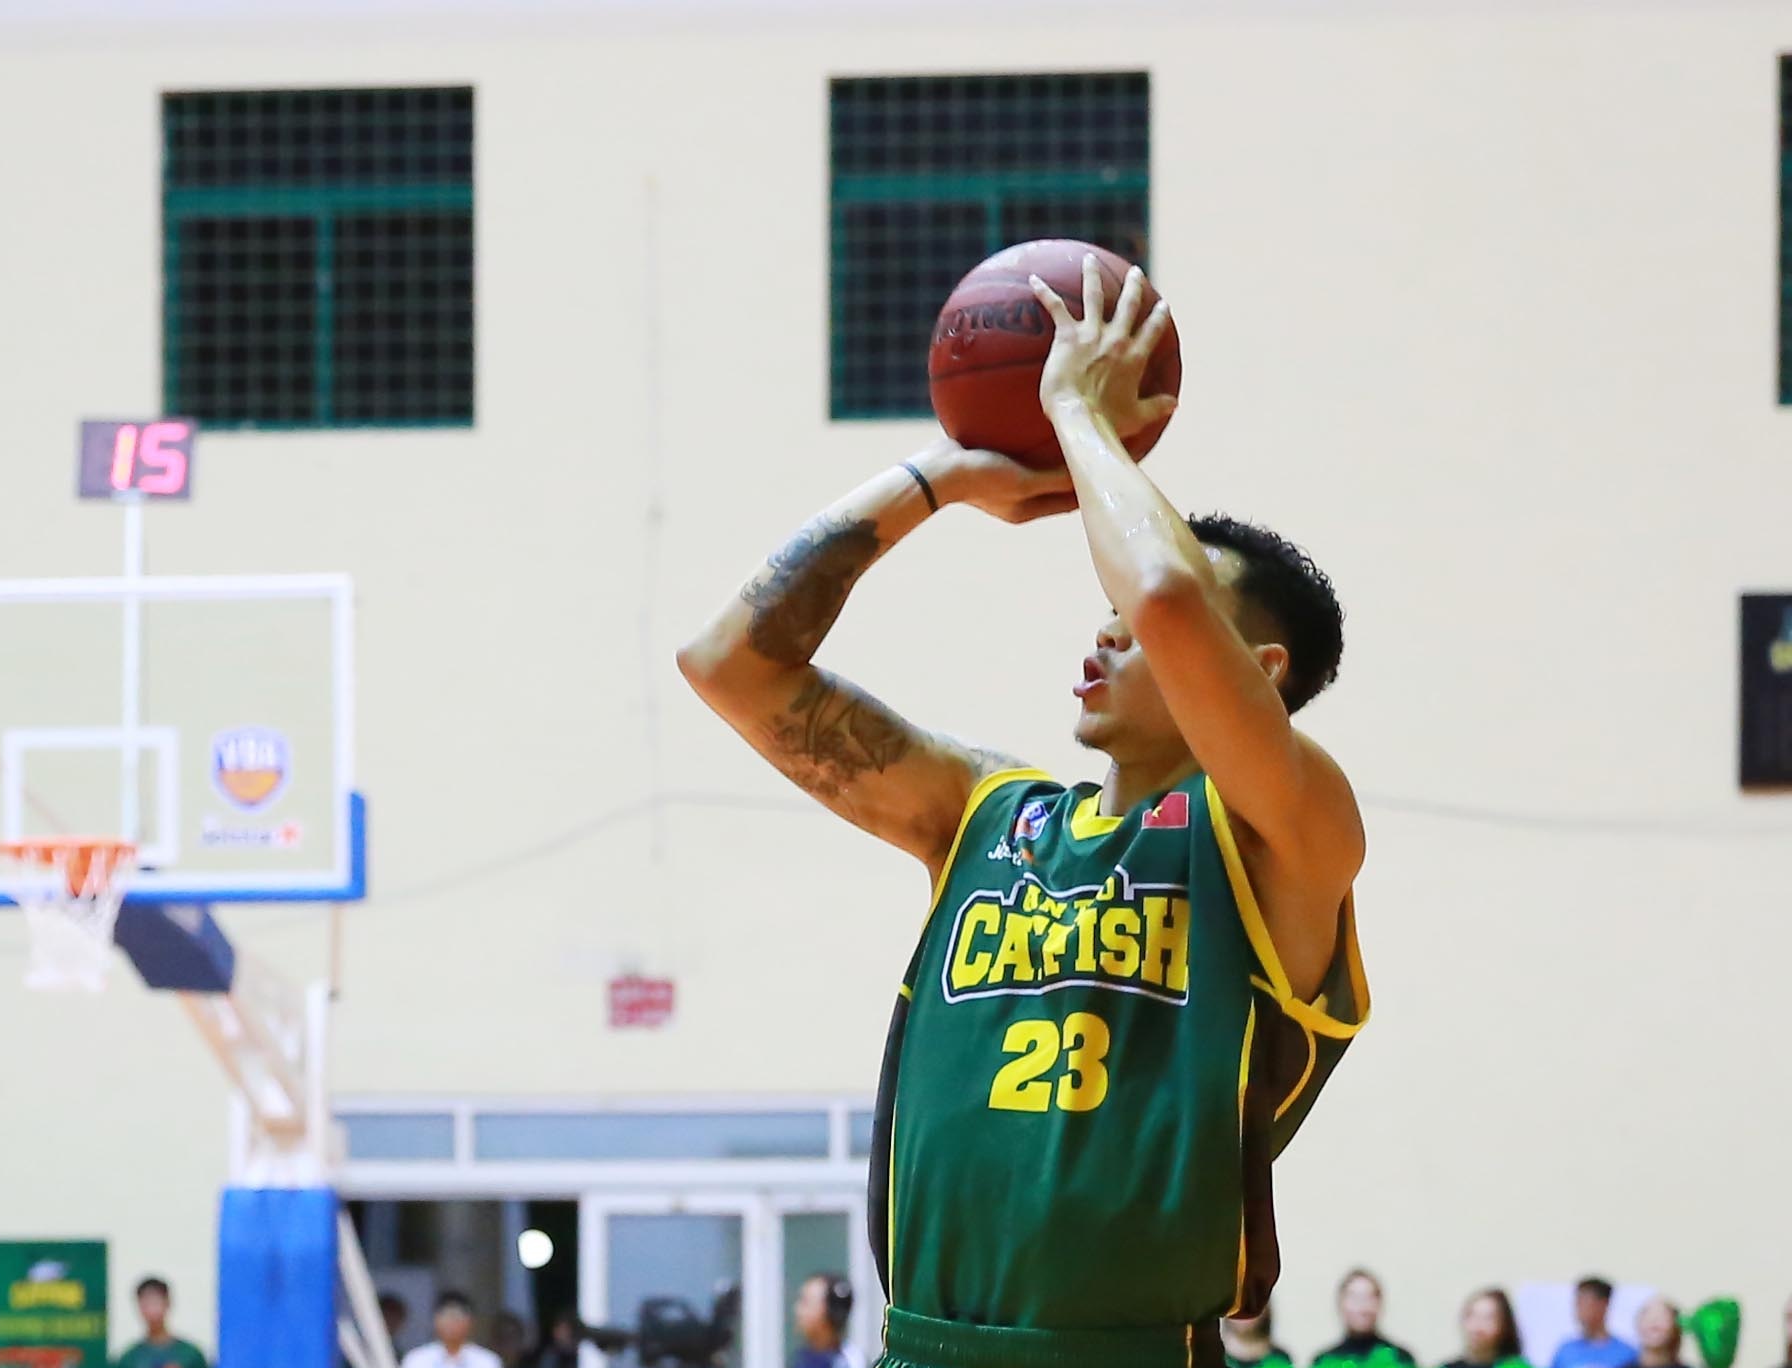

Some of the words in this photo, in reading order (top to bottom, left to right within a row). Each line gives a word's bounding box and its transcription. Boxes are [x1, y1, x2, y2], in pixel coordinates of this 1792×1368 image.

[111, 421, 190, 494] 15
[951, 896, 1190, 992] CATFISH
[988, 1011, 1110, 1113] 23
